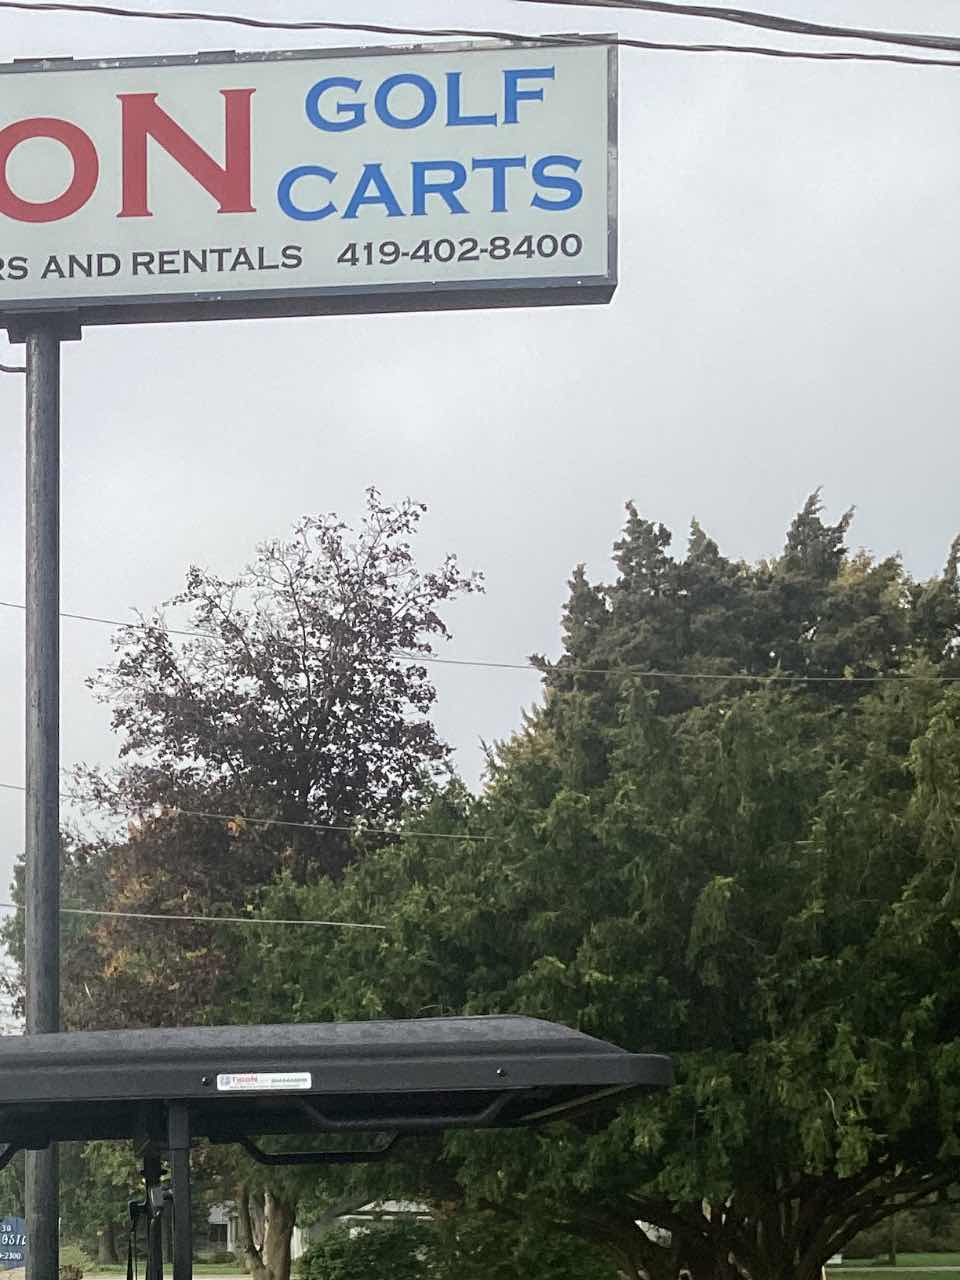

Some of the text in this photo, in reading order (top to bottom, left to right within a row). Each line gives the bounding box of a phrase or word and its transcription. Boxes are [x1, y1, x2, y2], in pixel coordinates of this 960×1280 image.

[305, 66, 555, 133] GOLF
[277, 154, 584, 221] CARTS
[41, 252, 121, 280] AND
[132, 244, 303, 276] RENTALS
[337, 232, 583, 266] 419-402-8400
